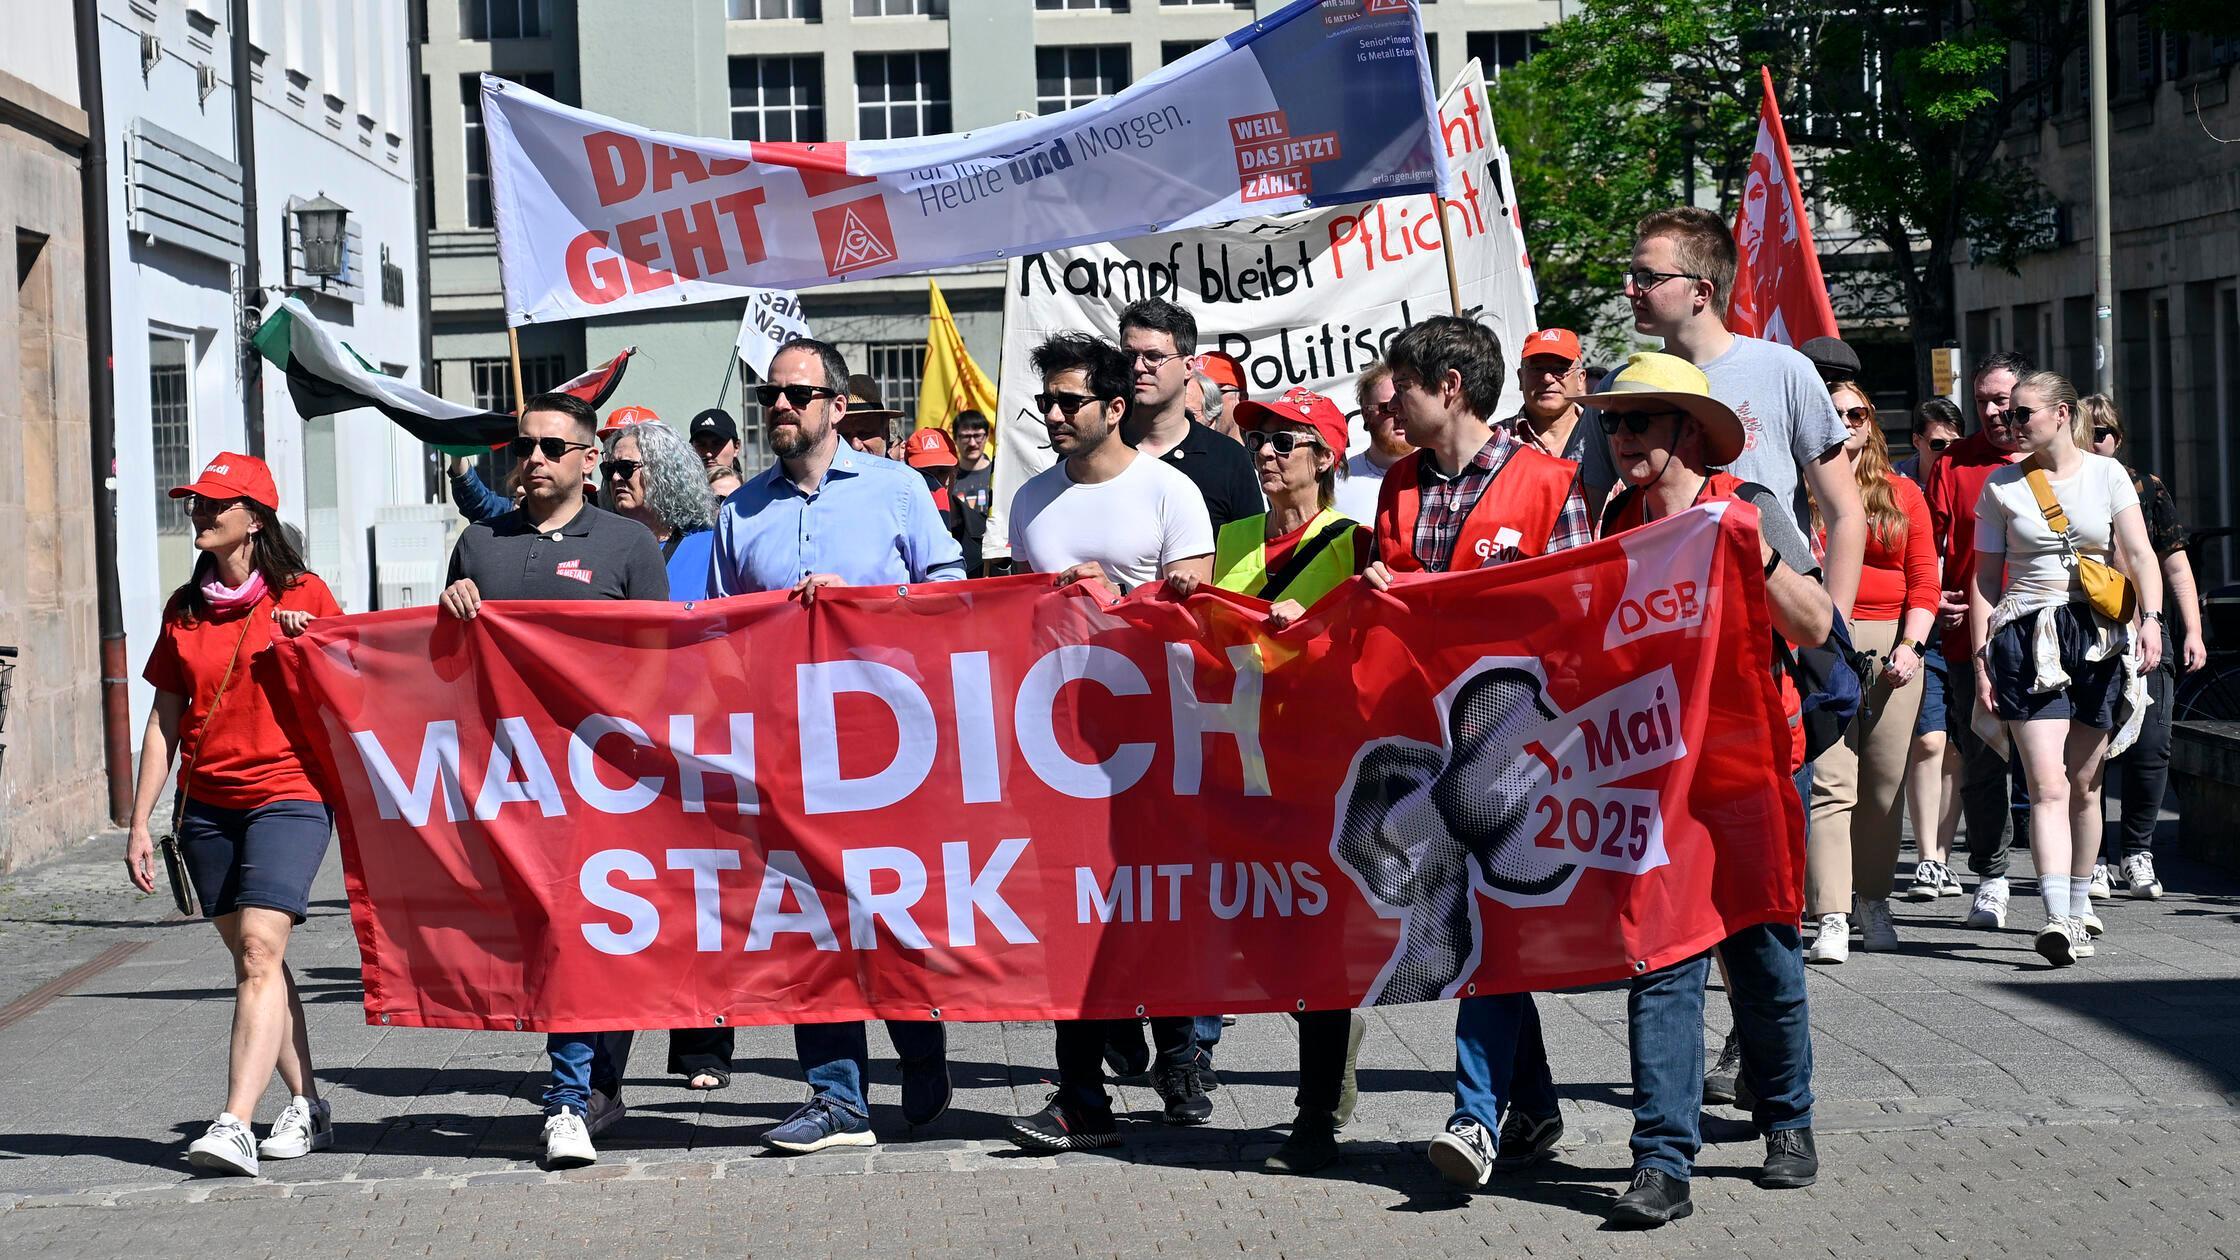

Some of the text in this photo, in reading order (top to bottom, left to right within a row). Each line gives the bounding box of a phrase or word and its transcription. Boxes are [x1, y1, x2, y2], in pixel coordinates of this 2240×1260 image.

[1325, 12, 1361, 24] IG METALL
[1357, 48, 1416, 62] IG Metall Erlan
[1234, 116, 1283, 140] WEIL
[917, 104, 1192, 217] Heute und Morgen.
[1241, 137, 1335, 169] DAS JETZT
[1245, 171, 1308, 199] ZÄHLT.
[565, 186, 768, 305] GEHT
[1020, 241, 1184, 303] Kampf
[1197, 240, 1314, 303] bleibt
[205, 463, 230, 477] er.di
[558, 560, 580, 569] TEAM
[1474, 538, 1520, 563] GEW
[1617, 580, 1700, 636] DGB
[349, 641, 1273, 828] MACH DICH
[1522, 684, 1673, 786] 1. Mai
[1533, 794, 1651, 862] 2025
[579, 837, 1329, 956] STARK MIT UNS
